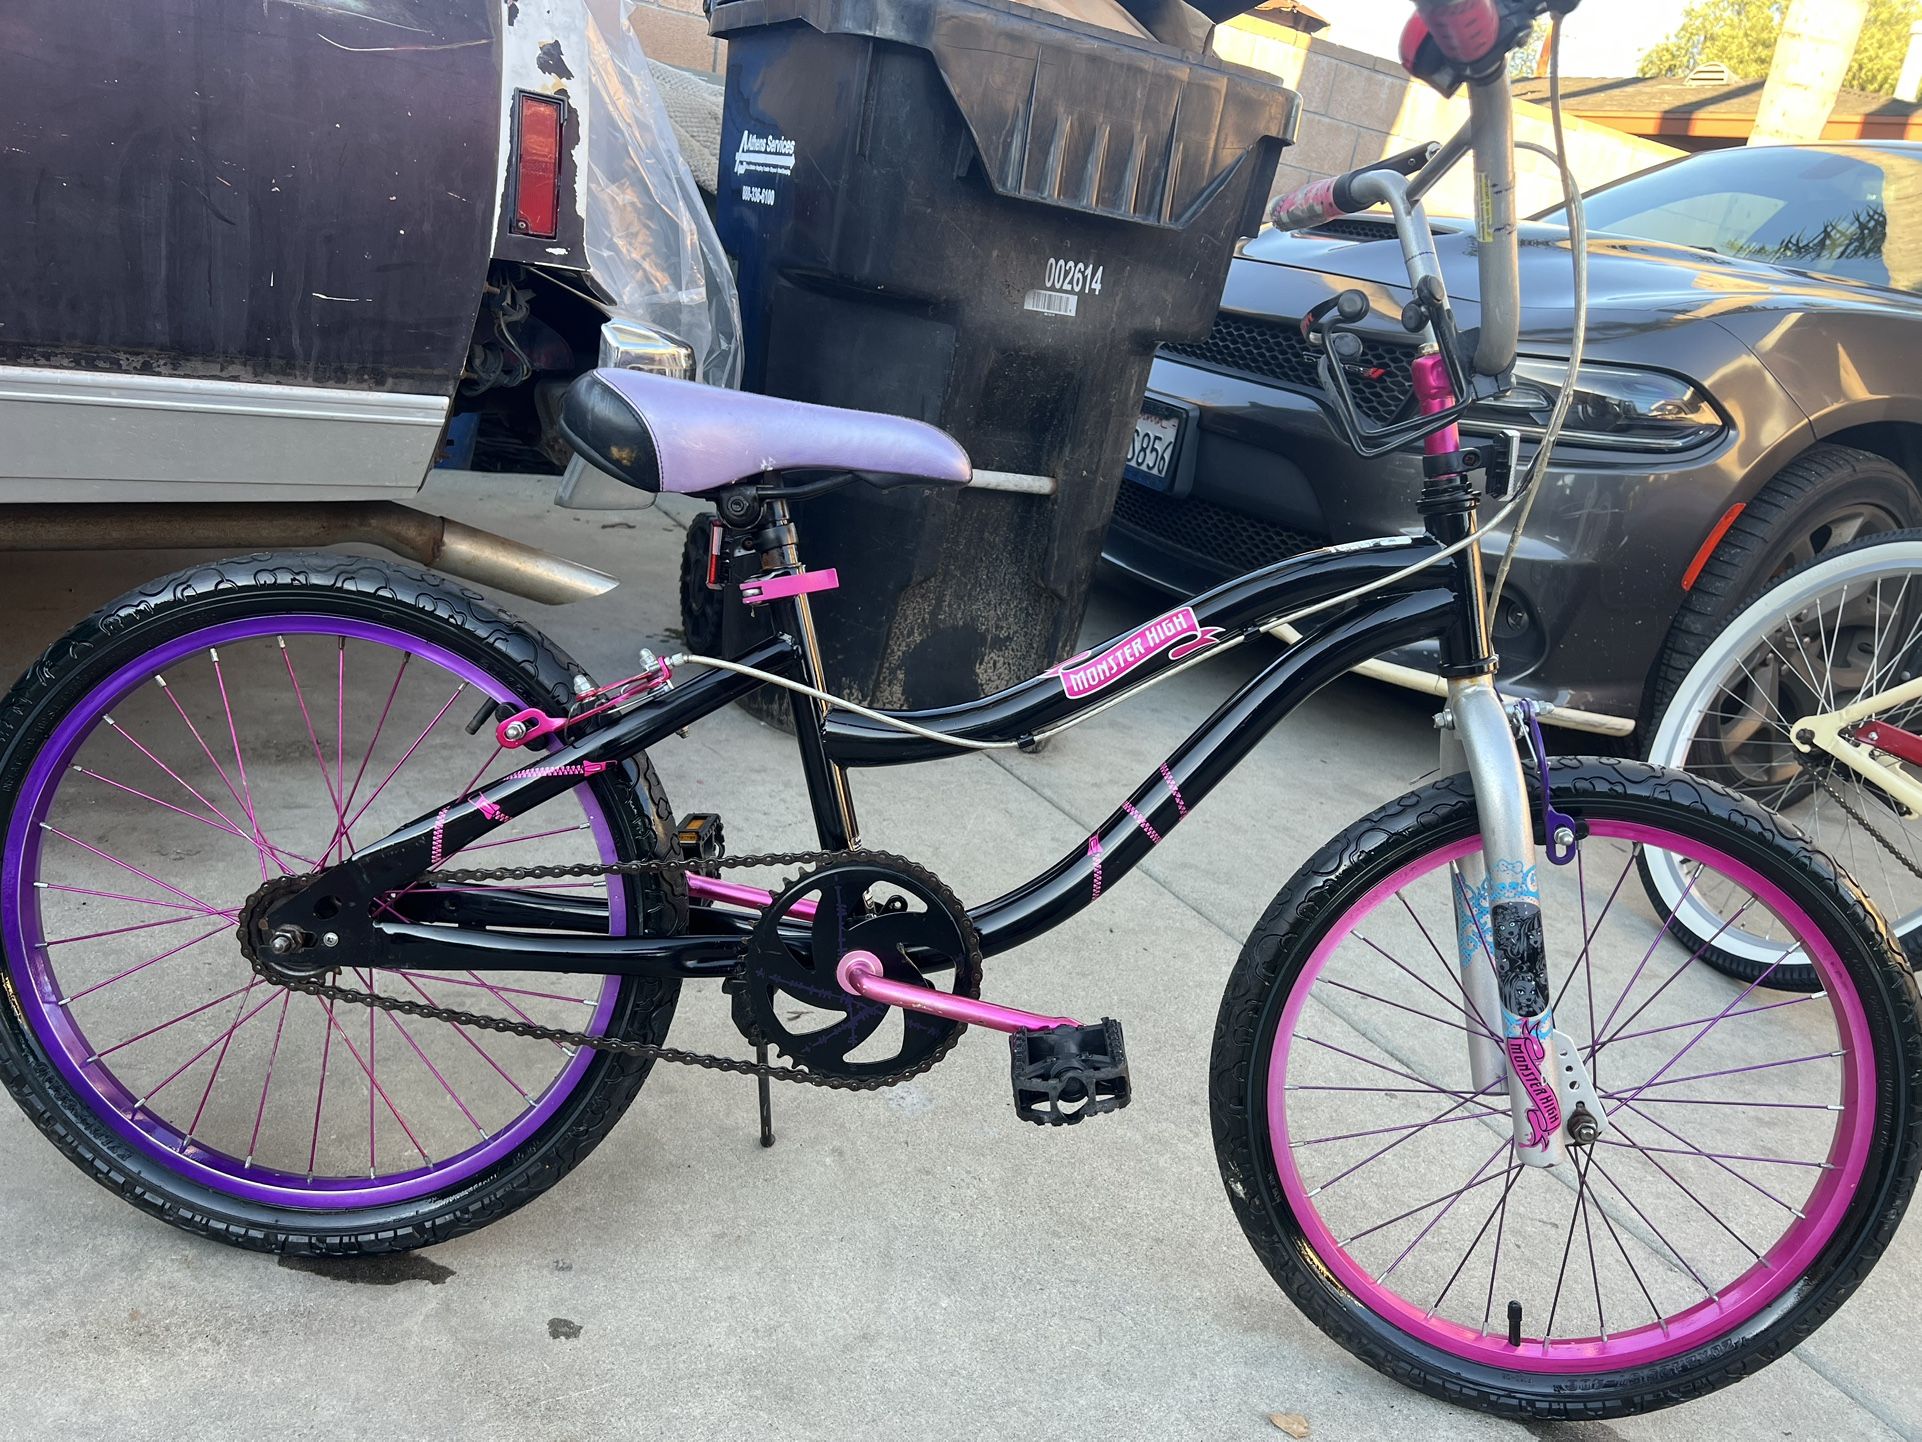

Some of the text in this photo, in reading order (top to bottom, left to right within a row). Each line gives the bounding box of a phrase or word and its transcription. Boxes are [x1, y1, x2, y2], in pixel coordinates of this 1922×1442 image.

[767, 134, 796, 154] Services
[1045, 257, 1103, 295] 002614
[1069, 614, 1188, 692] MONSTER HIGH
[1510, 1043, 1560, 1124] MONSTER HIGH
